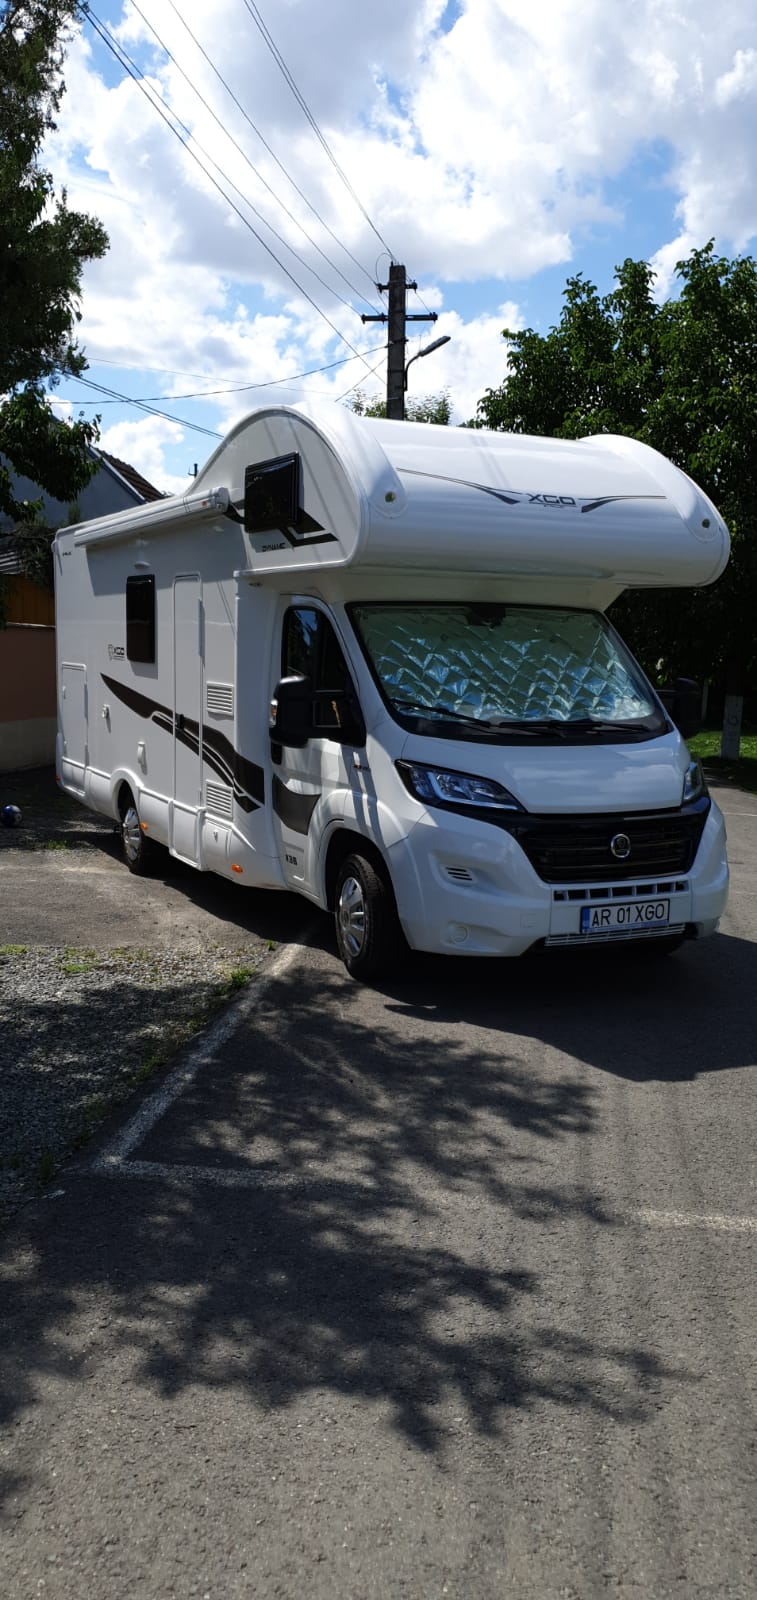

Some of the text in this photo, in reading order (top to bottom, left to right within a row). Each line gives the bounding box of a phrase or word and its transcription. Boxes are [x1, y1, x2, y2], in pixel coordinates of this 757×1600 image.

[527, 493, 577, 506] XGO
[591, 908, 611, 927] AR
[616, 906, 631, 924] 01
[634, 903, 665, 922] XGO
